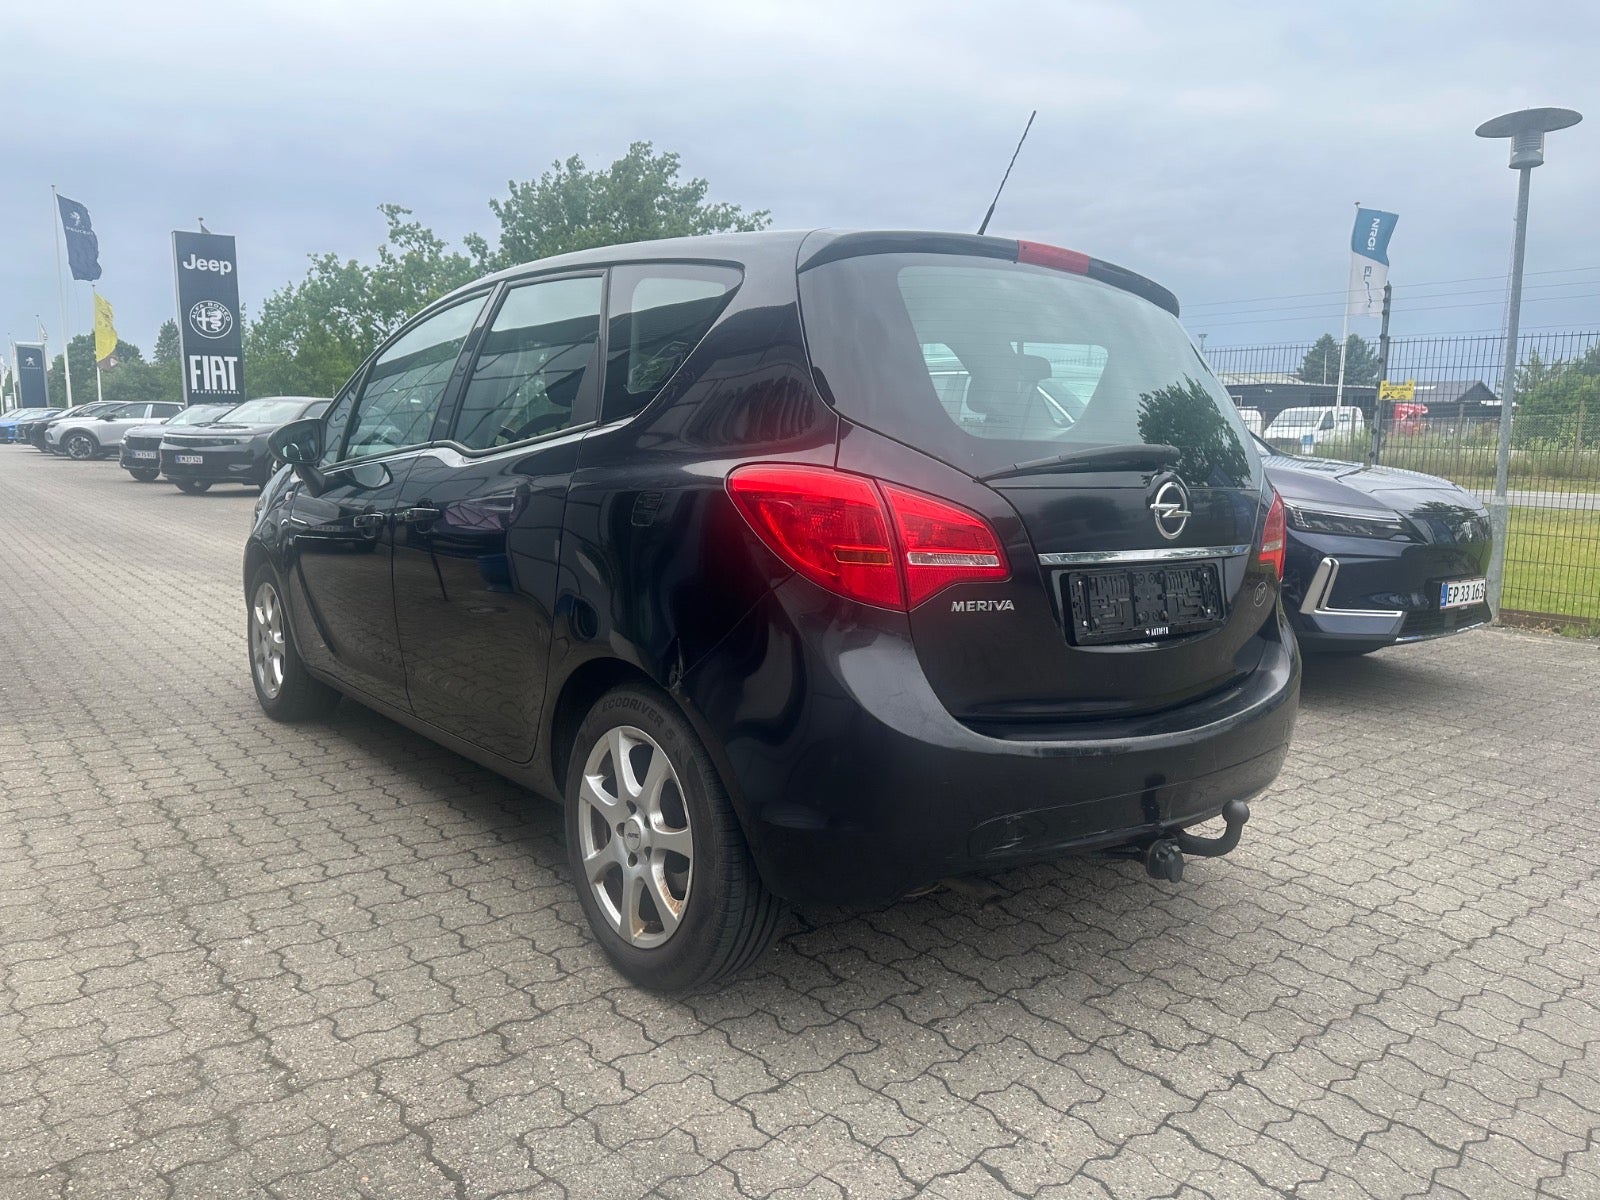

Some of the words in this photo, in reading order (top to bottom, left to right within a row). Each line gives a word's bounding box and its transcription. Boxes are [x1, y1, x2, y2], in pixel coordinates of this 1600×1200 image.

[183, 254, 232, 275] Jeep
[192, 304, 204, 319] ALFA
[207, 302, 230, 321] ROMEO
[189, 355, 238, 390] FIAT
[1447, 586, 1459, 603] EP
[1460, 585, 1470, 602] 33
[1472, 583, 1484, 600] 163
[950, 600, 1015, 612] MERIVA
[602, 697, 664, 727] ECODRIVER
